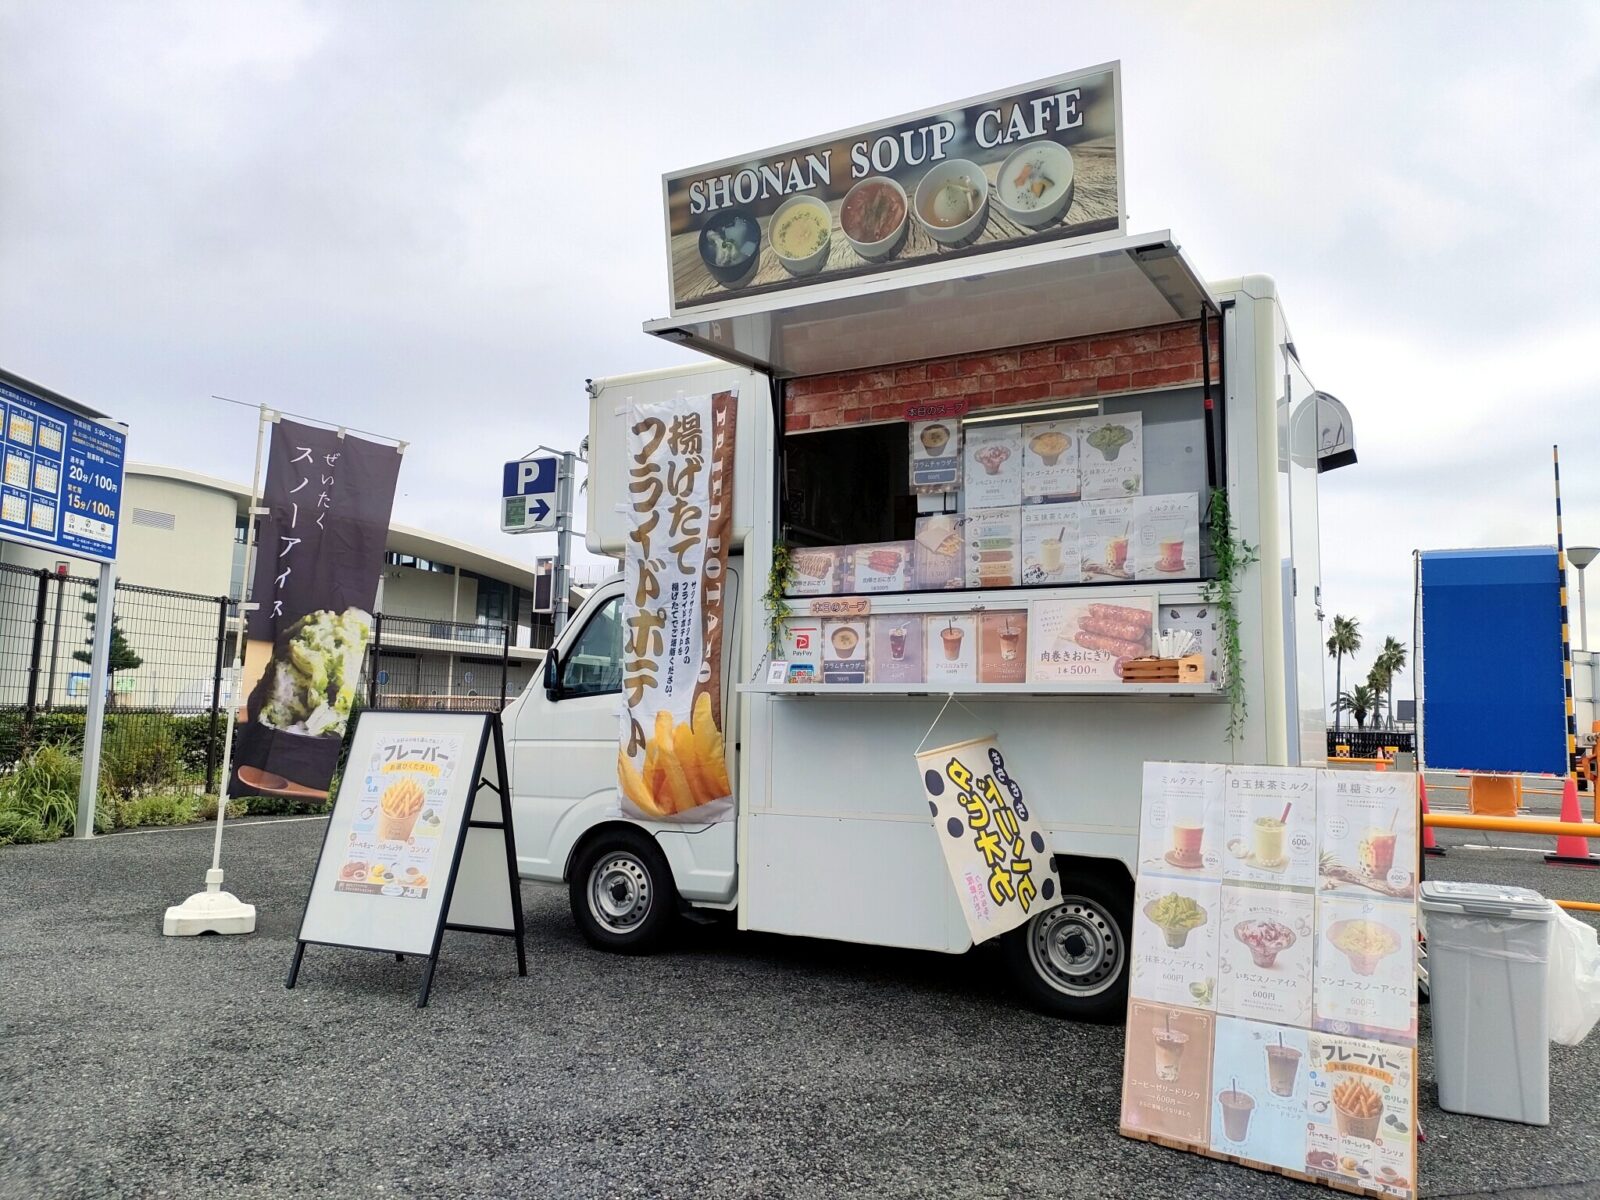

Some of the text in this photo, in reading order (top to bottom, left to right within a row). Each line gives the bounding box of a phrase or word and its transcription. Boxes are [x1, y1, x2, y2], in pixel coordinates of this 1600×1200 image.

[689, 88, 1084, 214] SHONAN SOUP CAFE
[908, 403, 963, 417] 本日のスープ
[517, 461, 540, 495] P
[316, 452, 341, 531] ぜいたく
[667, 411, 705, 575] 揚げたて
[269, 446, 314, 619] スノーアイス
[624, 416, 667, 758] フライドポテト
[812, 600, 868, 613] 本日のスープ
[1041, 650, 1111, 663] 肉巻きおにぎり
[384, 744, 449, 762] フレーバー
[1161, 776, 1214, 786] ミルクティー
[1231, 778, 1310, 792] 白玉抹茶ミルク
[1336, 782, 1396, 795] 黒糖ミルク
[1145, 955, 1204, 970] 抹茶スノーアイス
[1235, 971, 1297, 987] いちごスノーアイス
[1321, 976, 1408, 996] マンゴースノーアイス
[1252, 990, 1275, 1000] 600円
[1322, 1045, 1400, 1070] フレーバー
[1131, 1079, 1200, 1100] コーヒーゼリードリンク
[1314, 1080, 1326, 1088] しお
[1384, 1094, 1409, 1105] のりしお
[1308, 1131, 1337, 1141] バーベキュー
[1381, 1147, 1404, 1158] コンソメ
